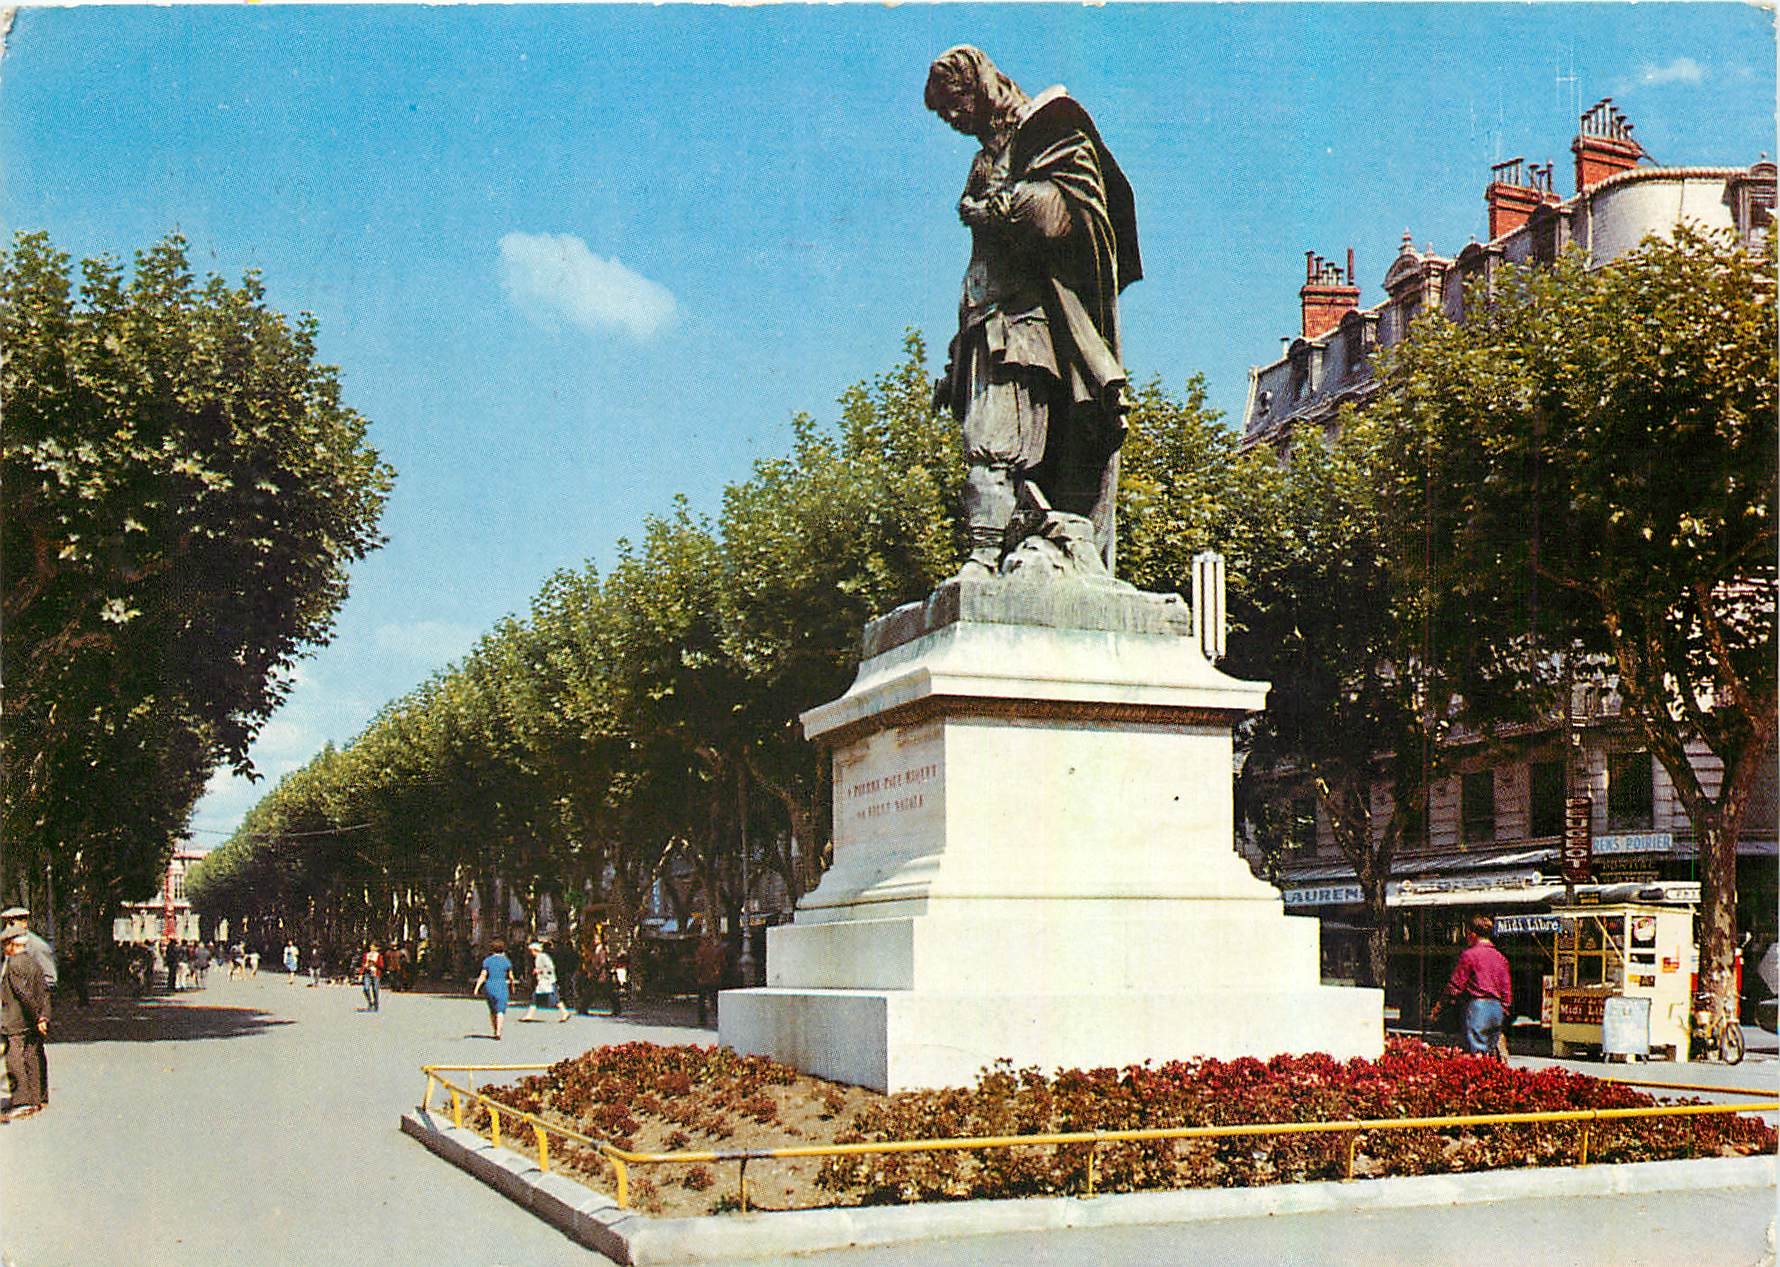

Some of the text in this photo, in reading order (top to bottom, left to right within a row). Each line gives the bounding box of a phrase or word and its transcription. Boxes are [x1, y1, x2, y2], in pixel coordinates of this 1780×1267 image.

[1284, 887, 1363, 904] LAUREN
[1497, 916, 1559, 930] Midi Libre
[1560, 1004, 1605, 1015] Midi Lib
